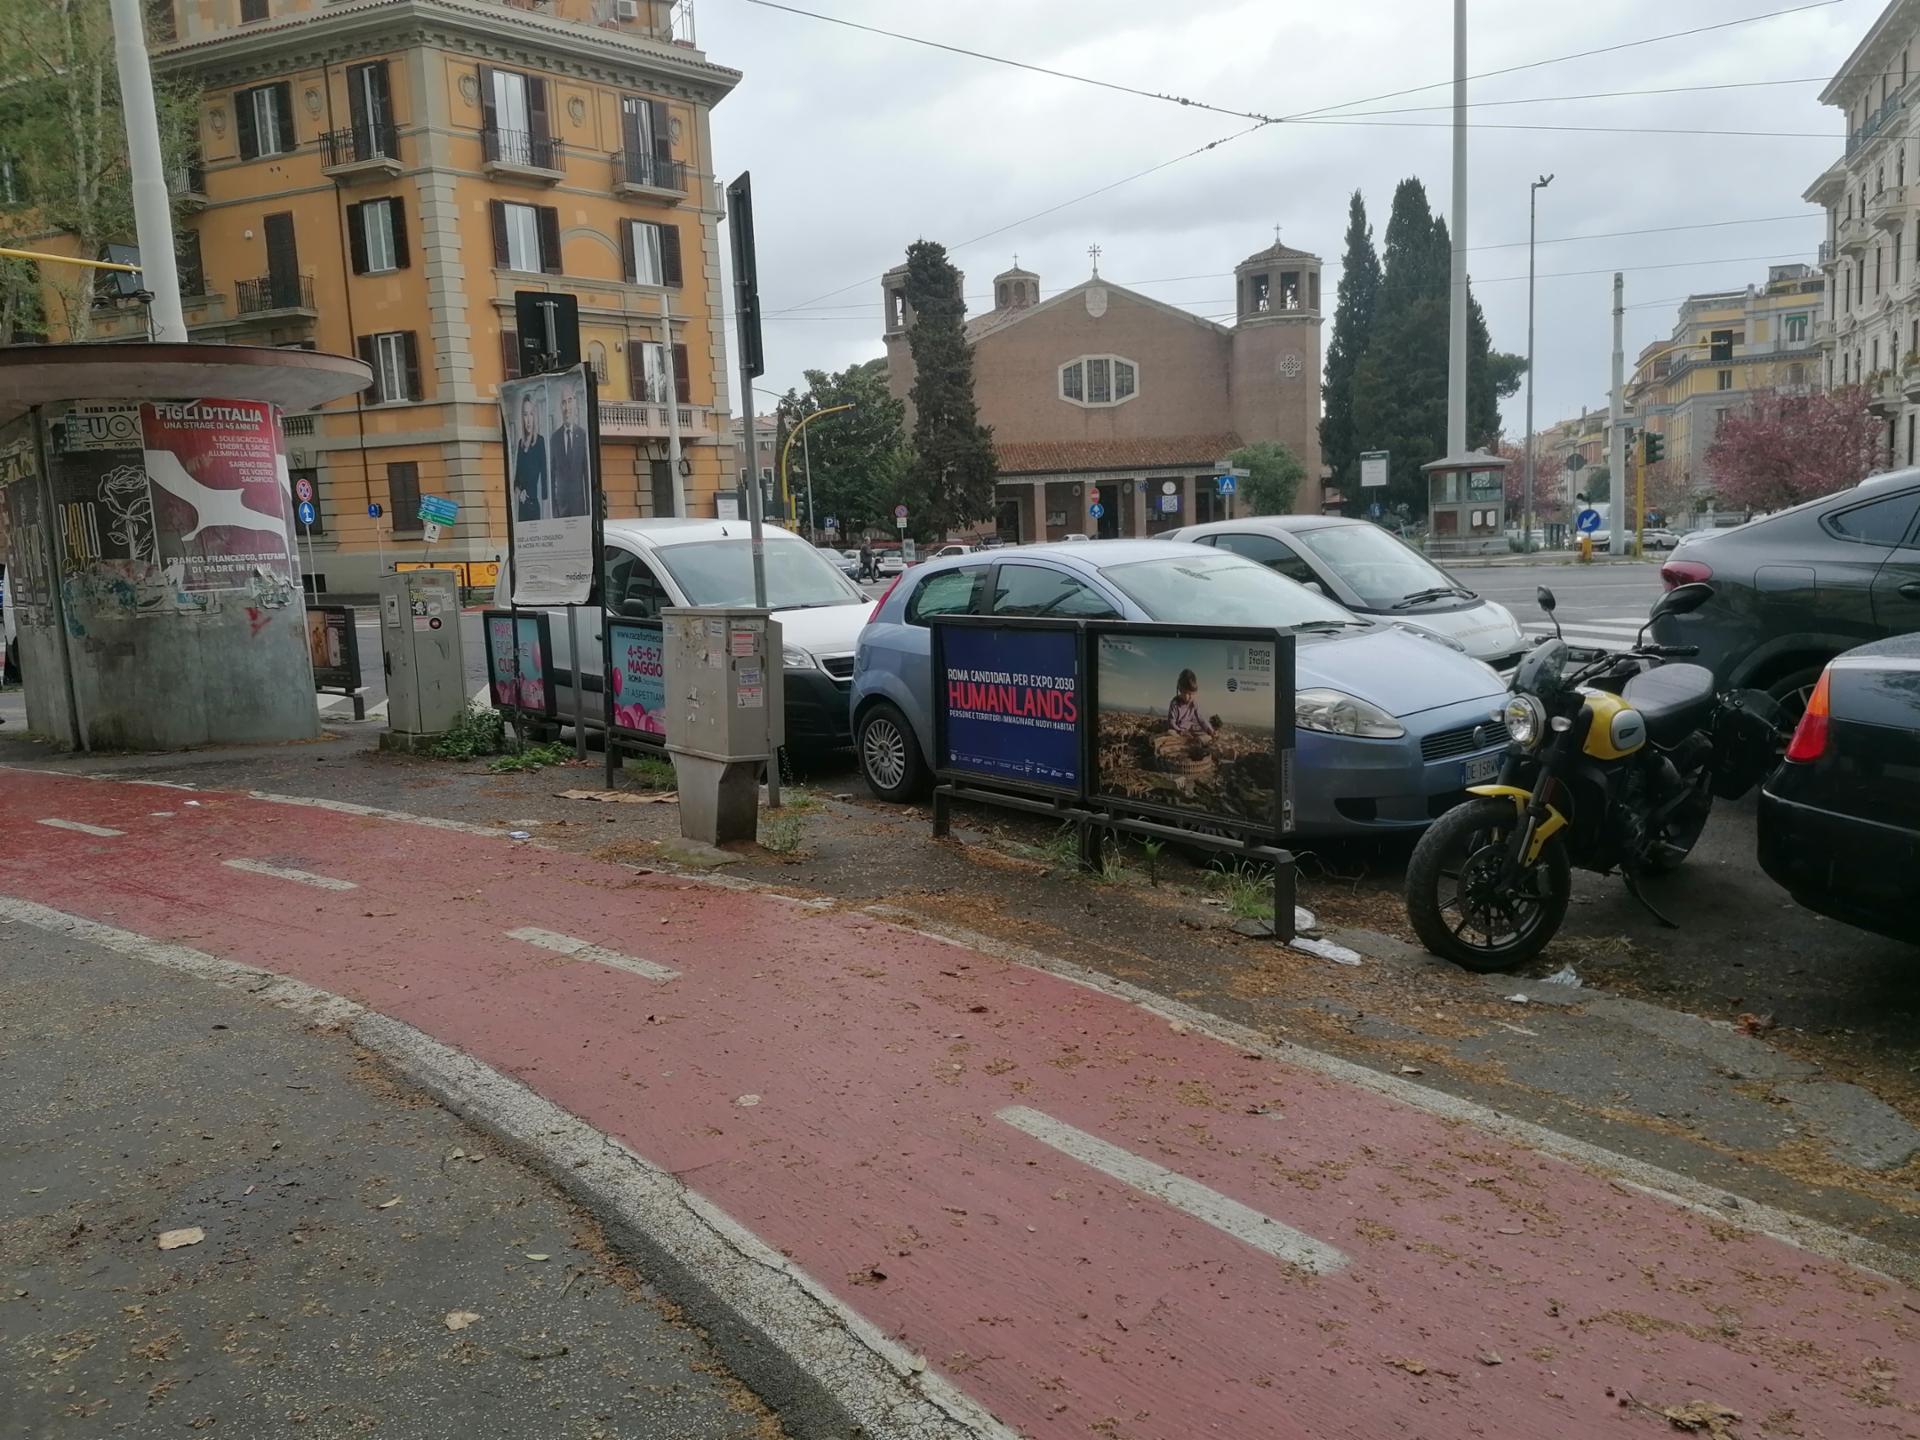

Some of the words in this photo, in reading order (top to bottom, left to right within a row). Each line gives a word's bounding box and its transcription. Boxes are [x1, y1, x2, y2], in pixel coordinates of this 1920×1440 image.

[154, 404, 200, 421] FIGLI
[202, 406, 264, 423] D'ITALIA
[163, 421, 182, 430] UNA
[183, 421, 215, 430] STRAGE
[216, 422, 224, 430] DI
[225, 422, 235, 430] 45
[208, 450, 240, 458] ILLUMINA
[191, 565, 202, 574] DI
[204, 563, 234, 573] PADRE
[235, 562, 246, 572] IN
[1248, 648, 1271, 657] Roma
[1248, 656, 1271, 666] Italia
[627, 659, 664, 678] MAGGIO
[947, 668, 969, 681] ROMA
[970, 669, 1012, 685] CANDIDATA
[1012, 673, 1029, 686] PER
[1030, 675, 1053, 689] EXPO
[1054, 677, 1075, 691] 2030
[948, 681, 1077, 722] HUMANLANDS
[1035, 719, 1054, 730] NUOVI
[1054, 721, 1076, 733] HABITAT
